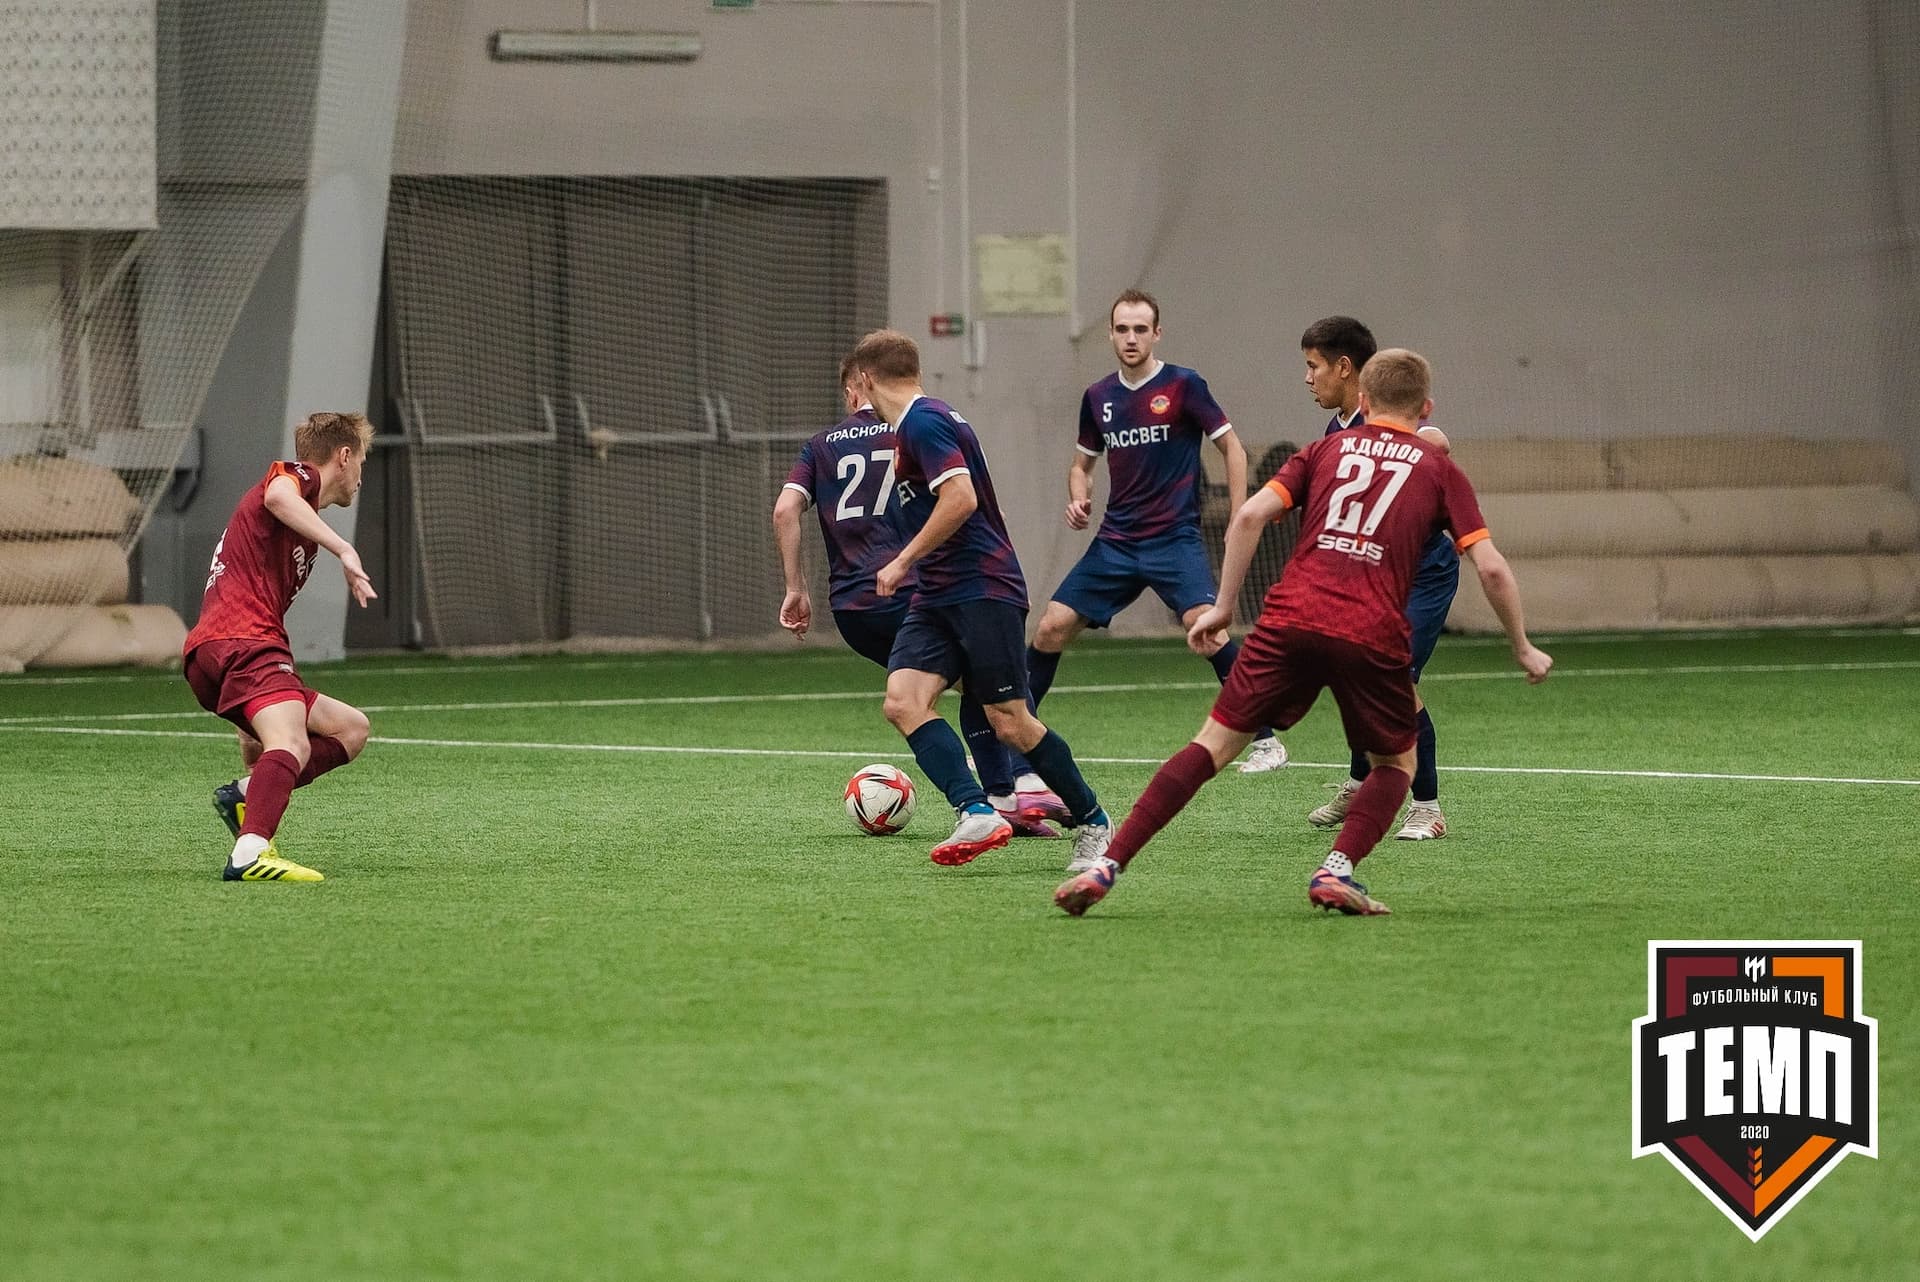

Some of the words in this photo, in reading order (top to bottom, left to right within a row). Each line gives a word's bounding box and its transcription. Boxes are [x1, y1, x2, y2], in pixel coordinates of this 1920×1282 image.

[1102, 402, 1113, 423] 5
[1102, 424, 1171, 449] РАССВЕТ
[1339, 436, 1424, 465] ЖДАНОВ
[835, 449, 896, 522] 27
[1324, 453, 1413, 536] 27
